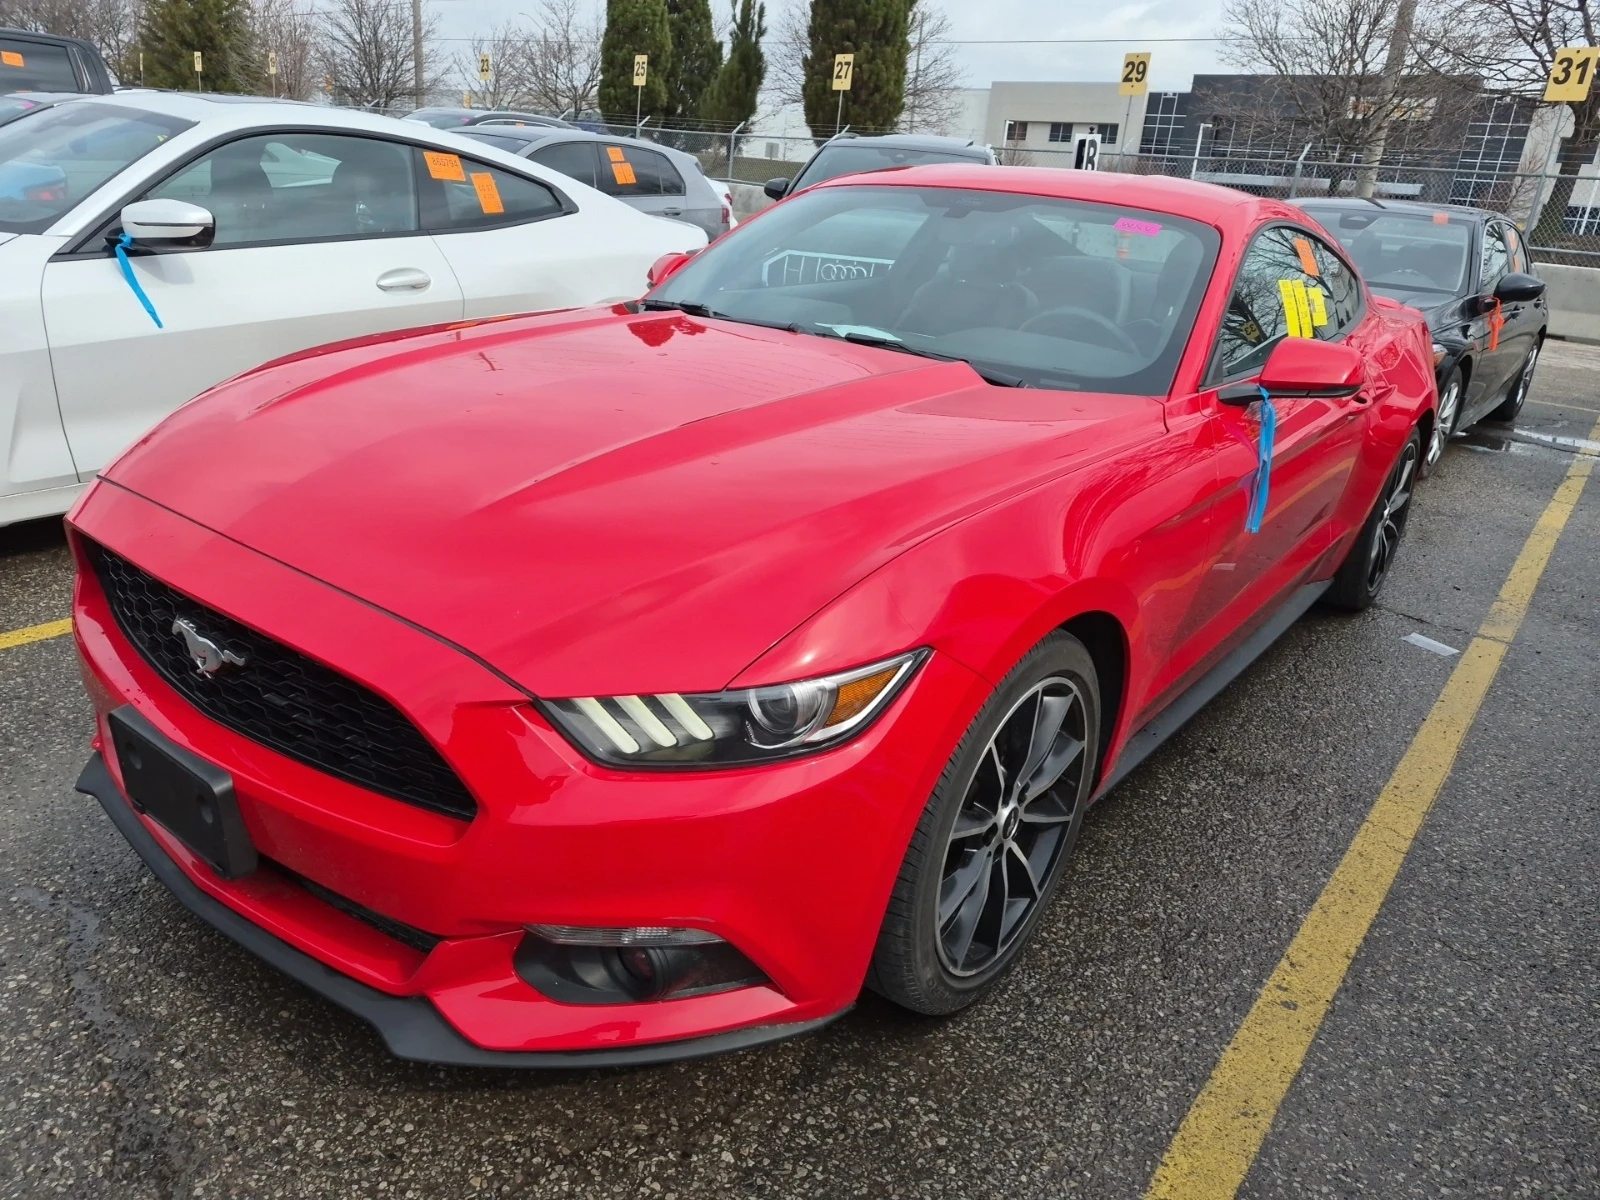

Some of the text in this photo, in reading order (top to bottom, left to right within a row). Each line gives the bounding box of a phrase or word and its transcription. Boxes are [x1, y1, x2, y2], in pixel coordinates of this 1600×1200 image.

[480, 58, 489, 73] 23
[634, 60, 646, 77] 25
[834, 60, 852, 80] 27
[1121, 60, 1147, 83] 29
[1552, 56, 1591, 85] 31
